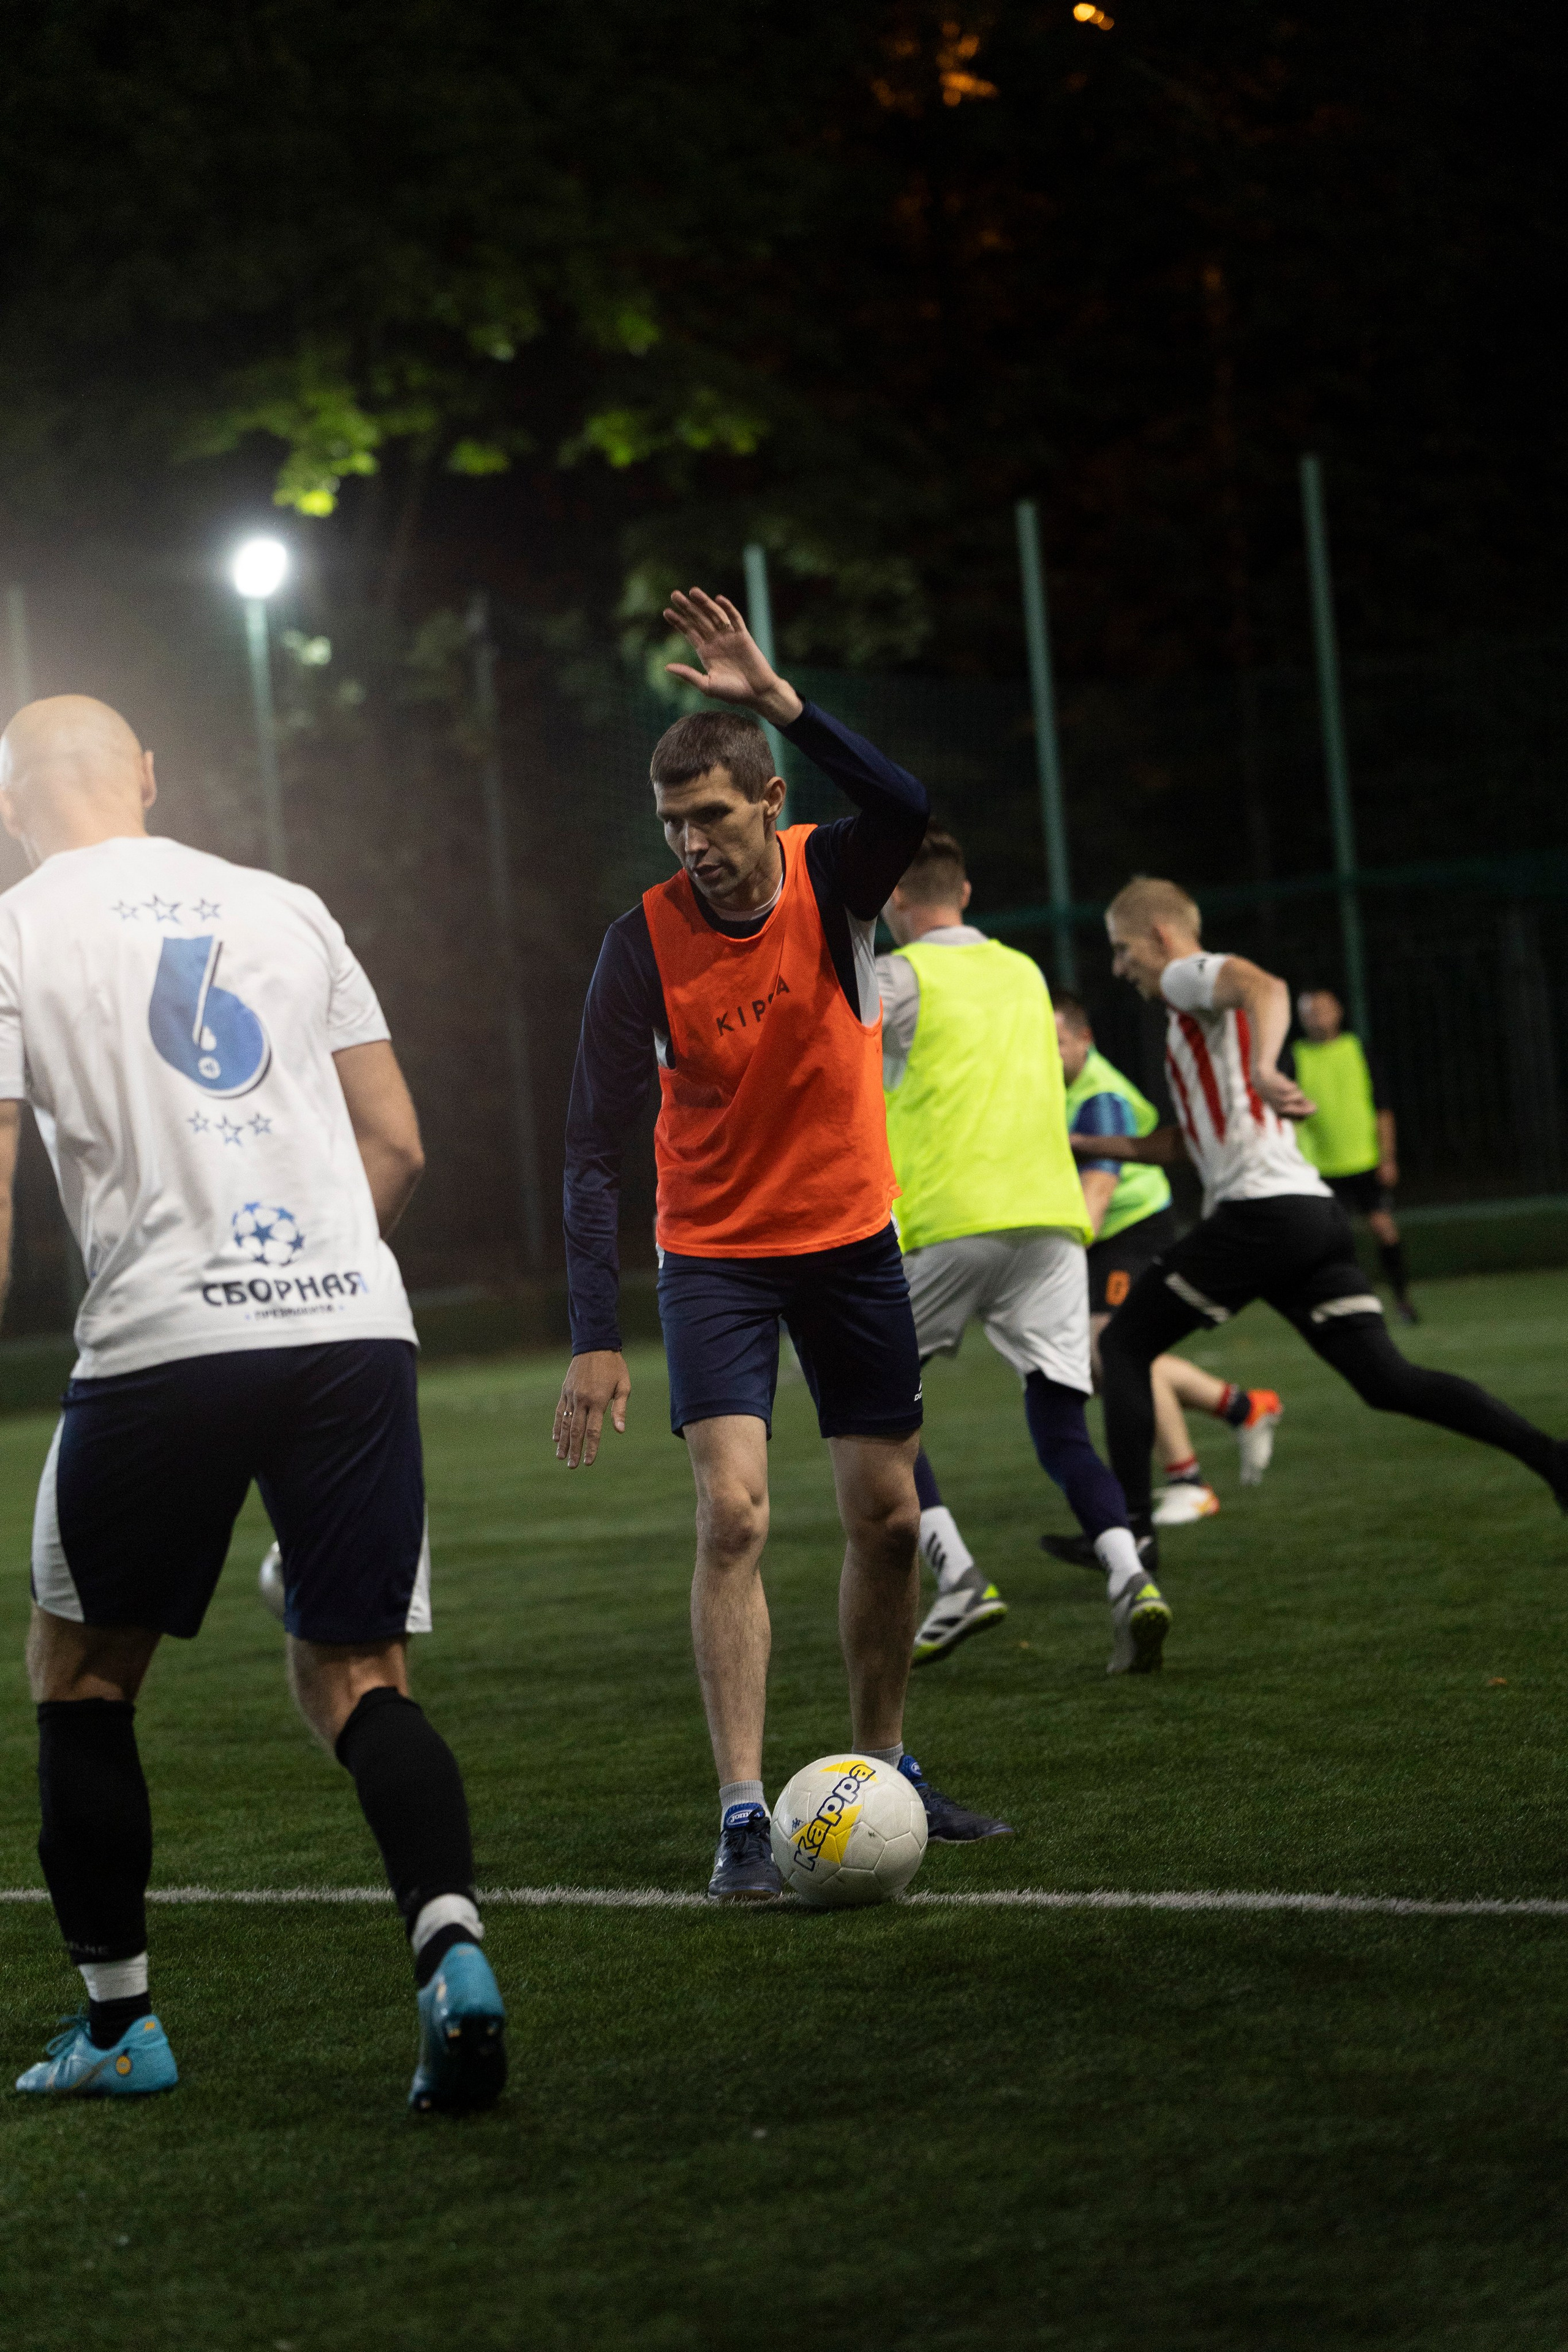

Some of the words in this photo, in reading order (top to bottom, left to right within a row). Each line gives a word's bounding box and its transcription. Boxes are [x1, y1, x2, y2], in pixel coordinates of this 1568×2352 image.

[148, 935, 271, 1099] 6
[203, 1272, 367, 1306] СБОРНАЯ
[794, 1764, 876, 1872] Kappa
